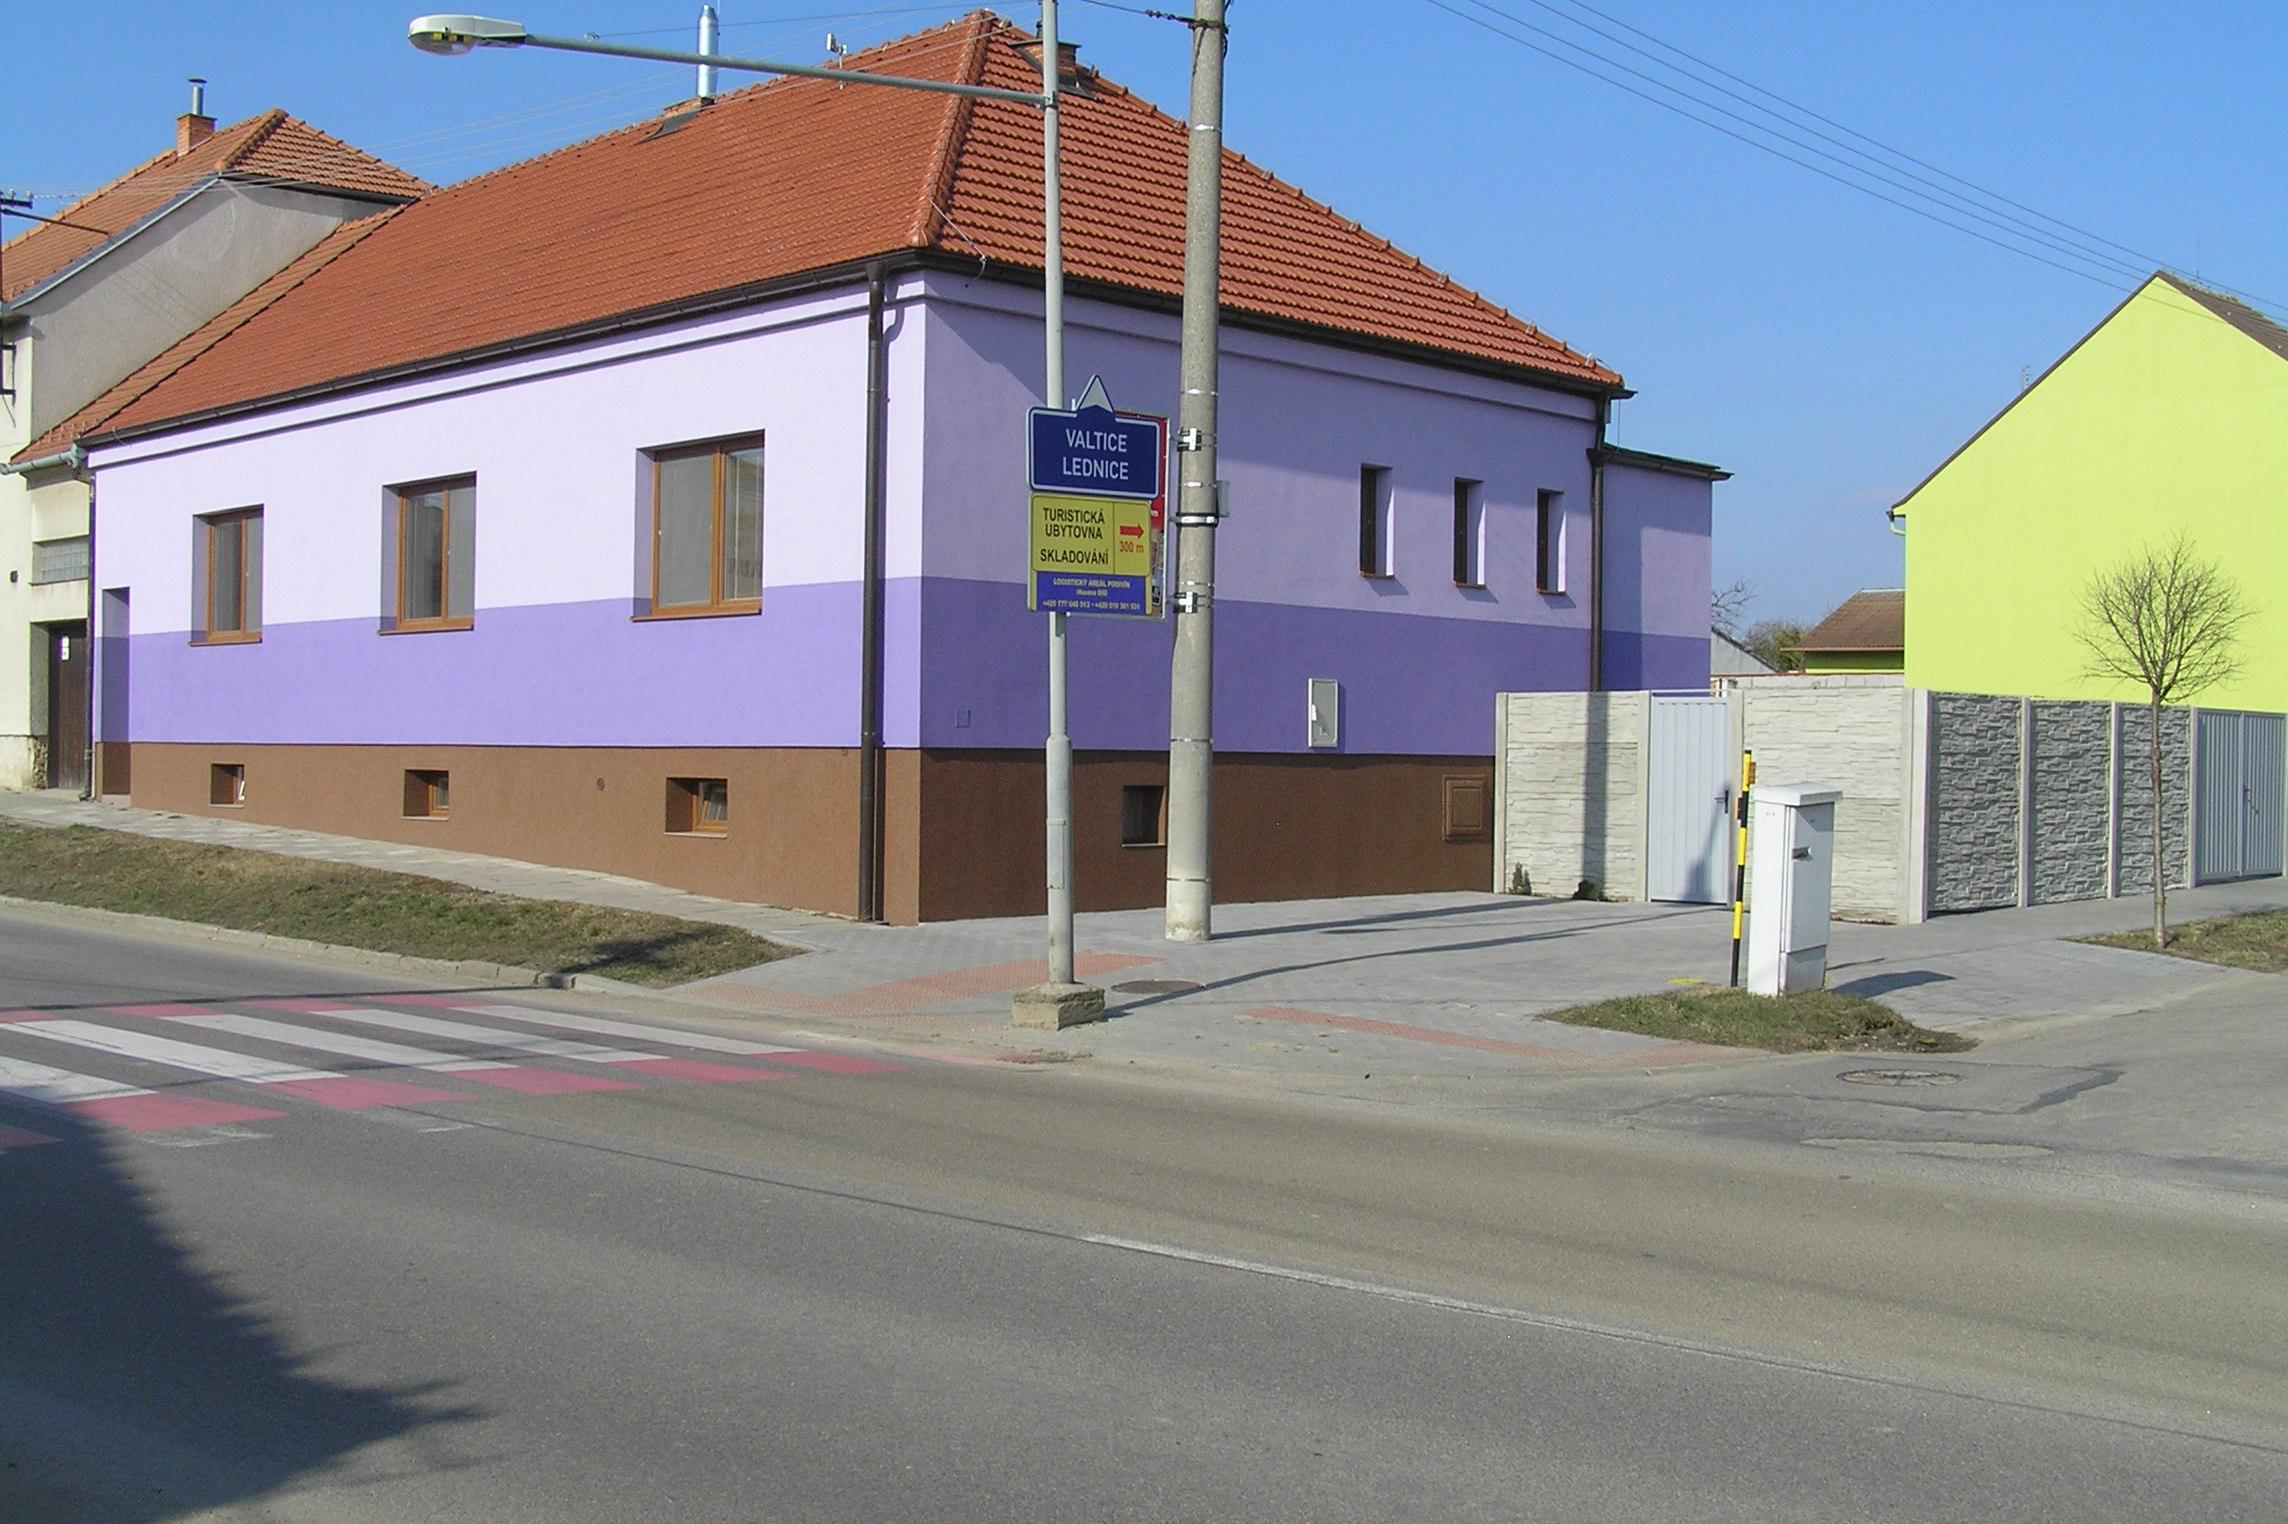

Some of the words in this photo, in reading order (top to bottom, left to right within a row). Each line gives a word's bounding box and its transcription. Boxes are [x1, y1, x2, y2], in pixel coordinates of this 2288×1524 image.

[1066, 429, 1128, 453] VALTICE
[1062, 456, 1129, 480] LEDNICE
[1043, 507, 1105, 524] TURISTICKÁ
[1045, 524, 1103, 539] UBYTOVNA
[1119, 541, 1133, 553] 300
[1136, 545, 1144, 554] m
[1040, 548, 1109, 565] SKLADOVÁNÍ
